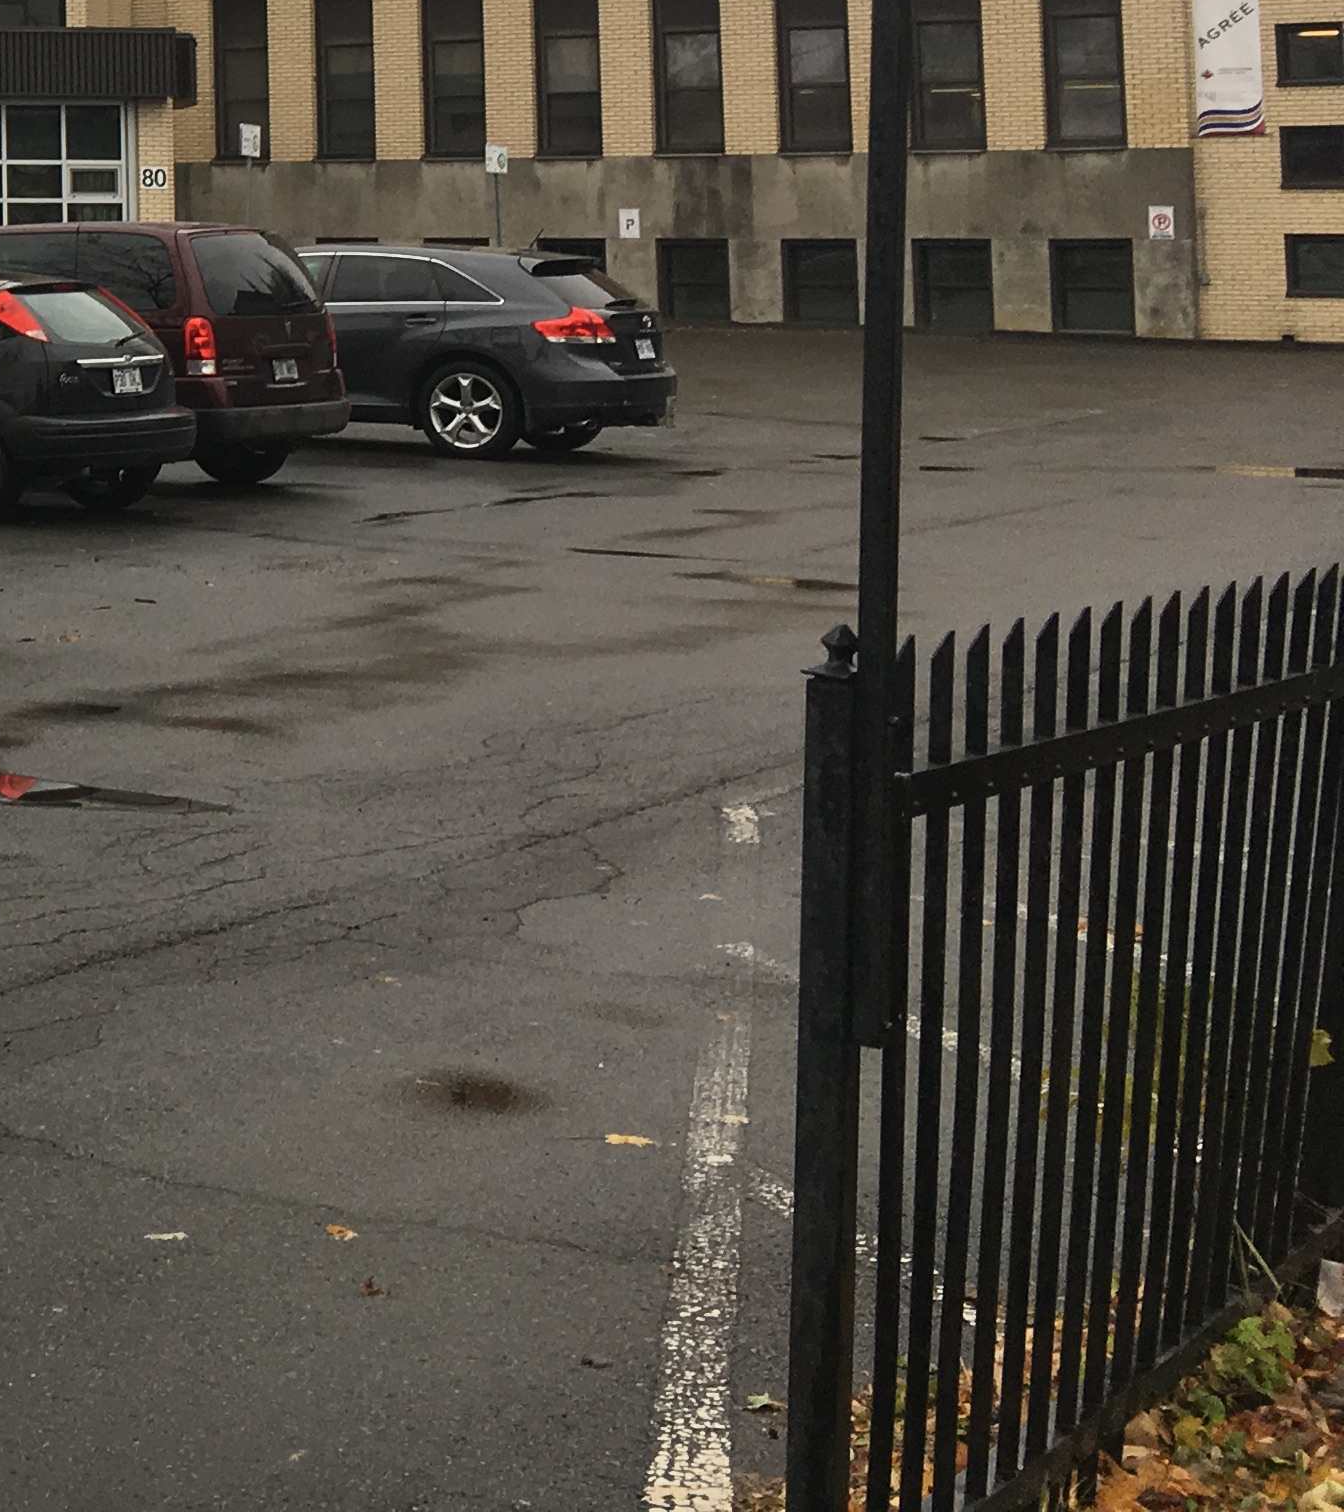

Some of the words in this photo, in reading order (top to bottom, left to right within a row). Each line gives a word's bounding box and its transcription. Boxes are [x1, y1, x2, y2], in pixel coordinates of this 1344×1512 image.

[1198, 2, 1254, 49] AGRÉÉ
[142, 169, 166, 187] 80
[626, 219, 635, 230] P
